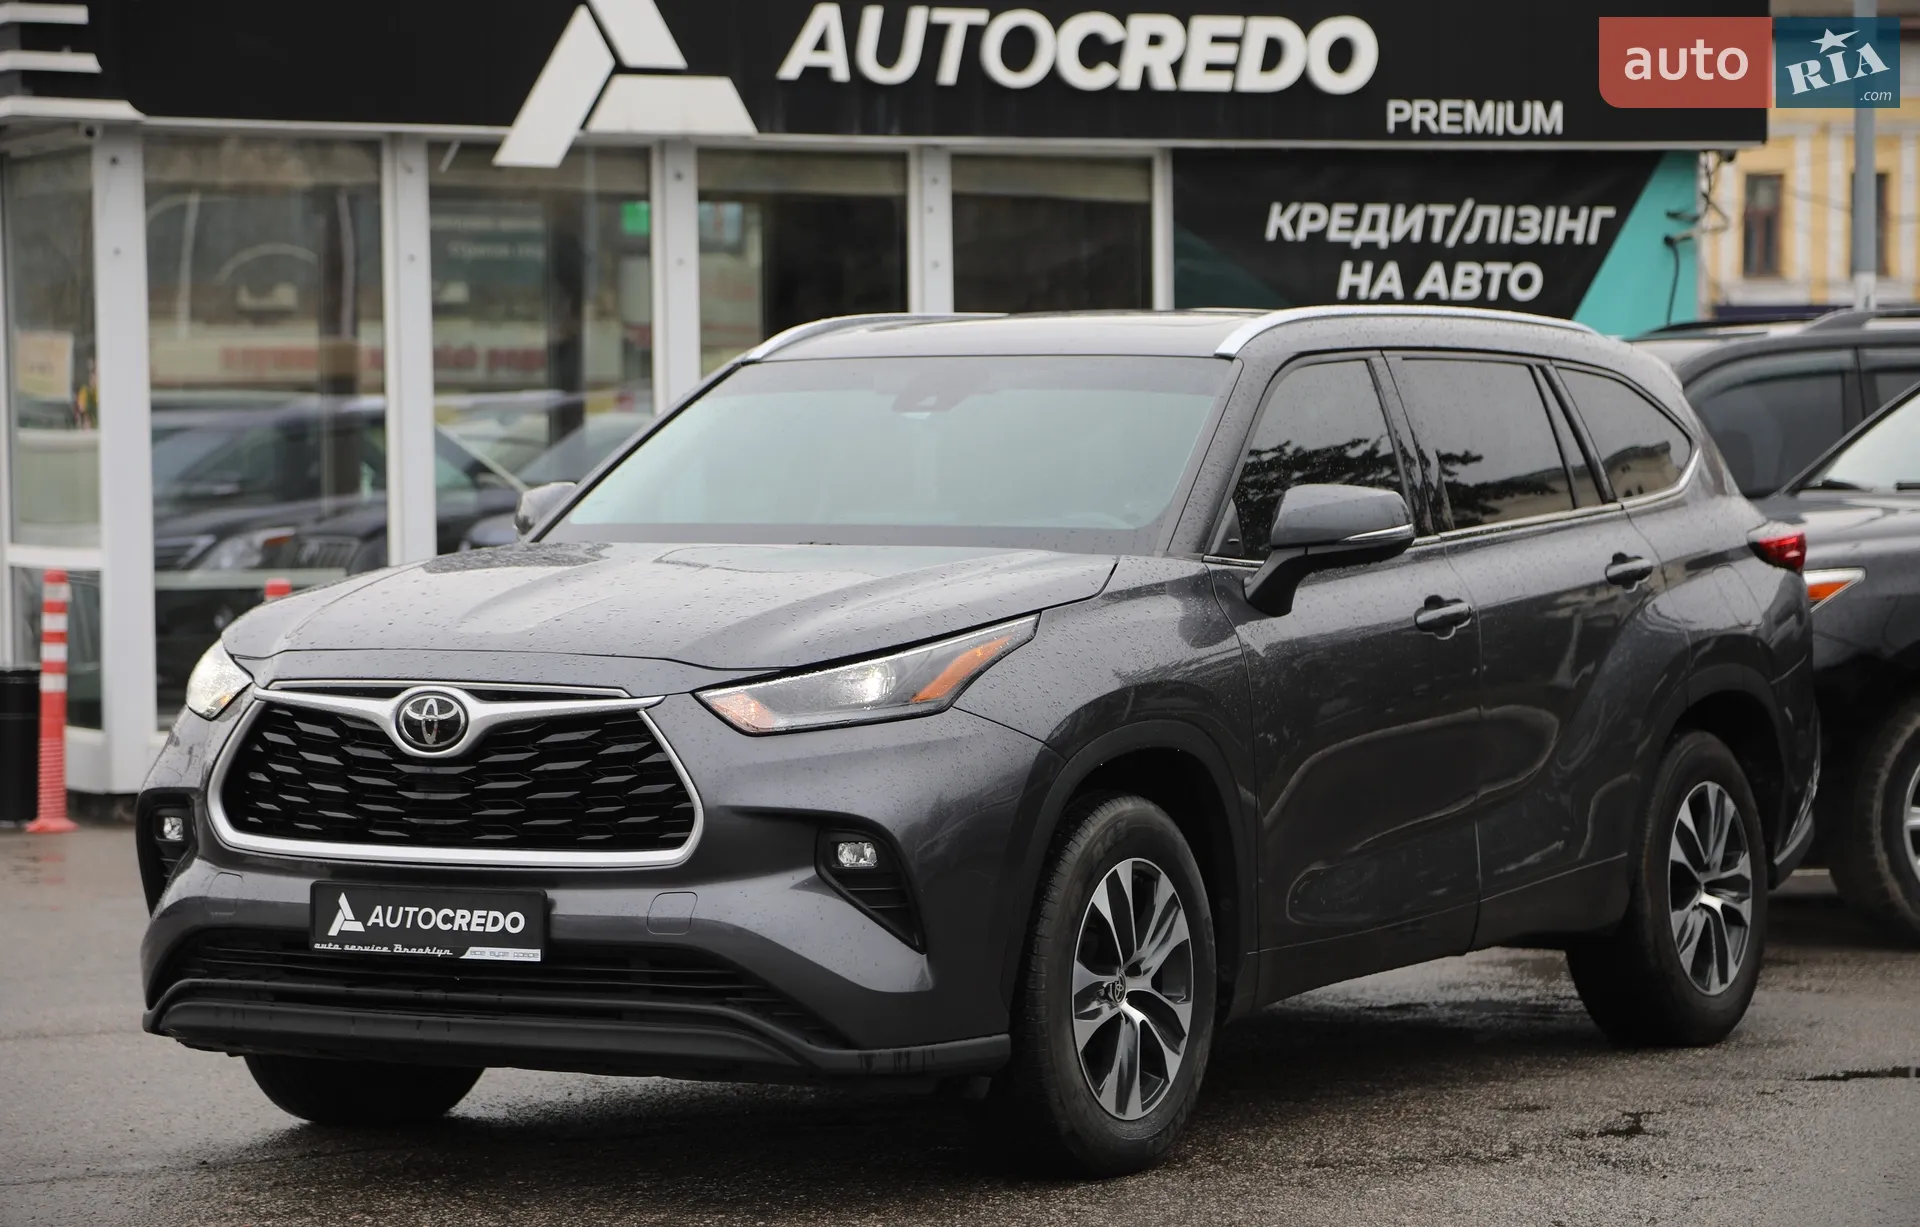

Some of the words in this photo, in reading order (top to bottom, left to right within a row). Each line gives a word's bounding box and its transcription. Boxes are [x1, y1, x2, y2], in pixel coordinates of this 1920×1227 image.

[776, 2, 1379, 95] AUTOCREDO
[1386, 99, 1564, 135] PREMIUM
[1265, 198, 1616, 249] КРЕДИТ/ЛІЗІНГ
[1336, 260, 1404, 301] НА
[1414, 261, 1544, 302] АВТО
[366, 905, 526, 934] AUTOCREDO
[314, 942, 342, 950] auto
[343, 944, 391, 953] service
[393, 943, 453, 957] Brooklyn
